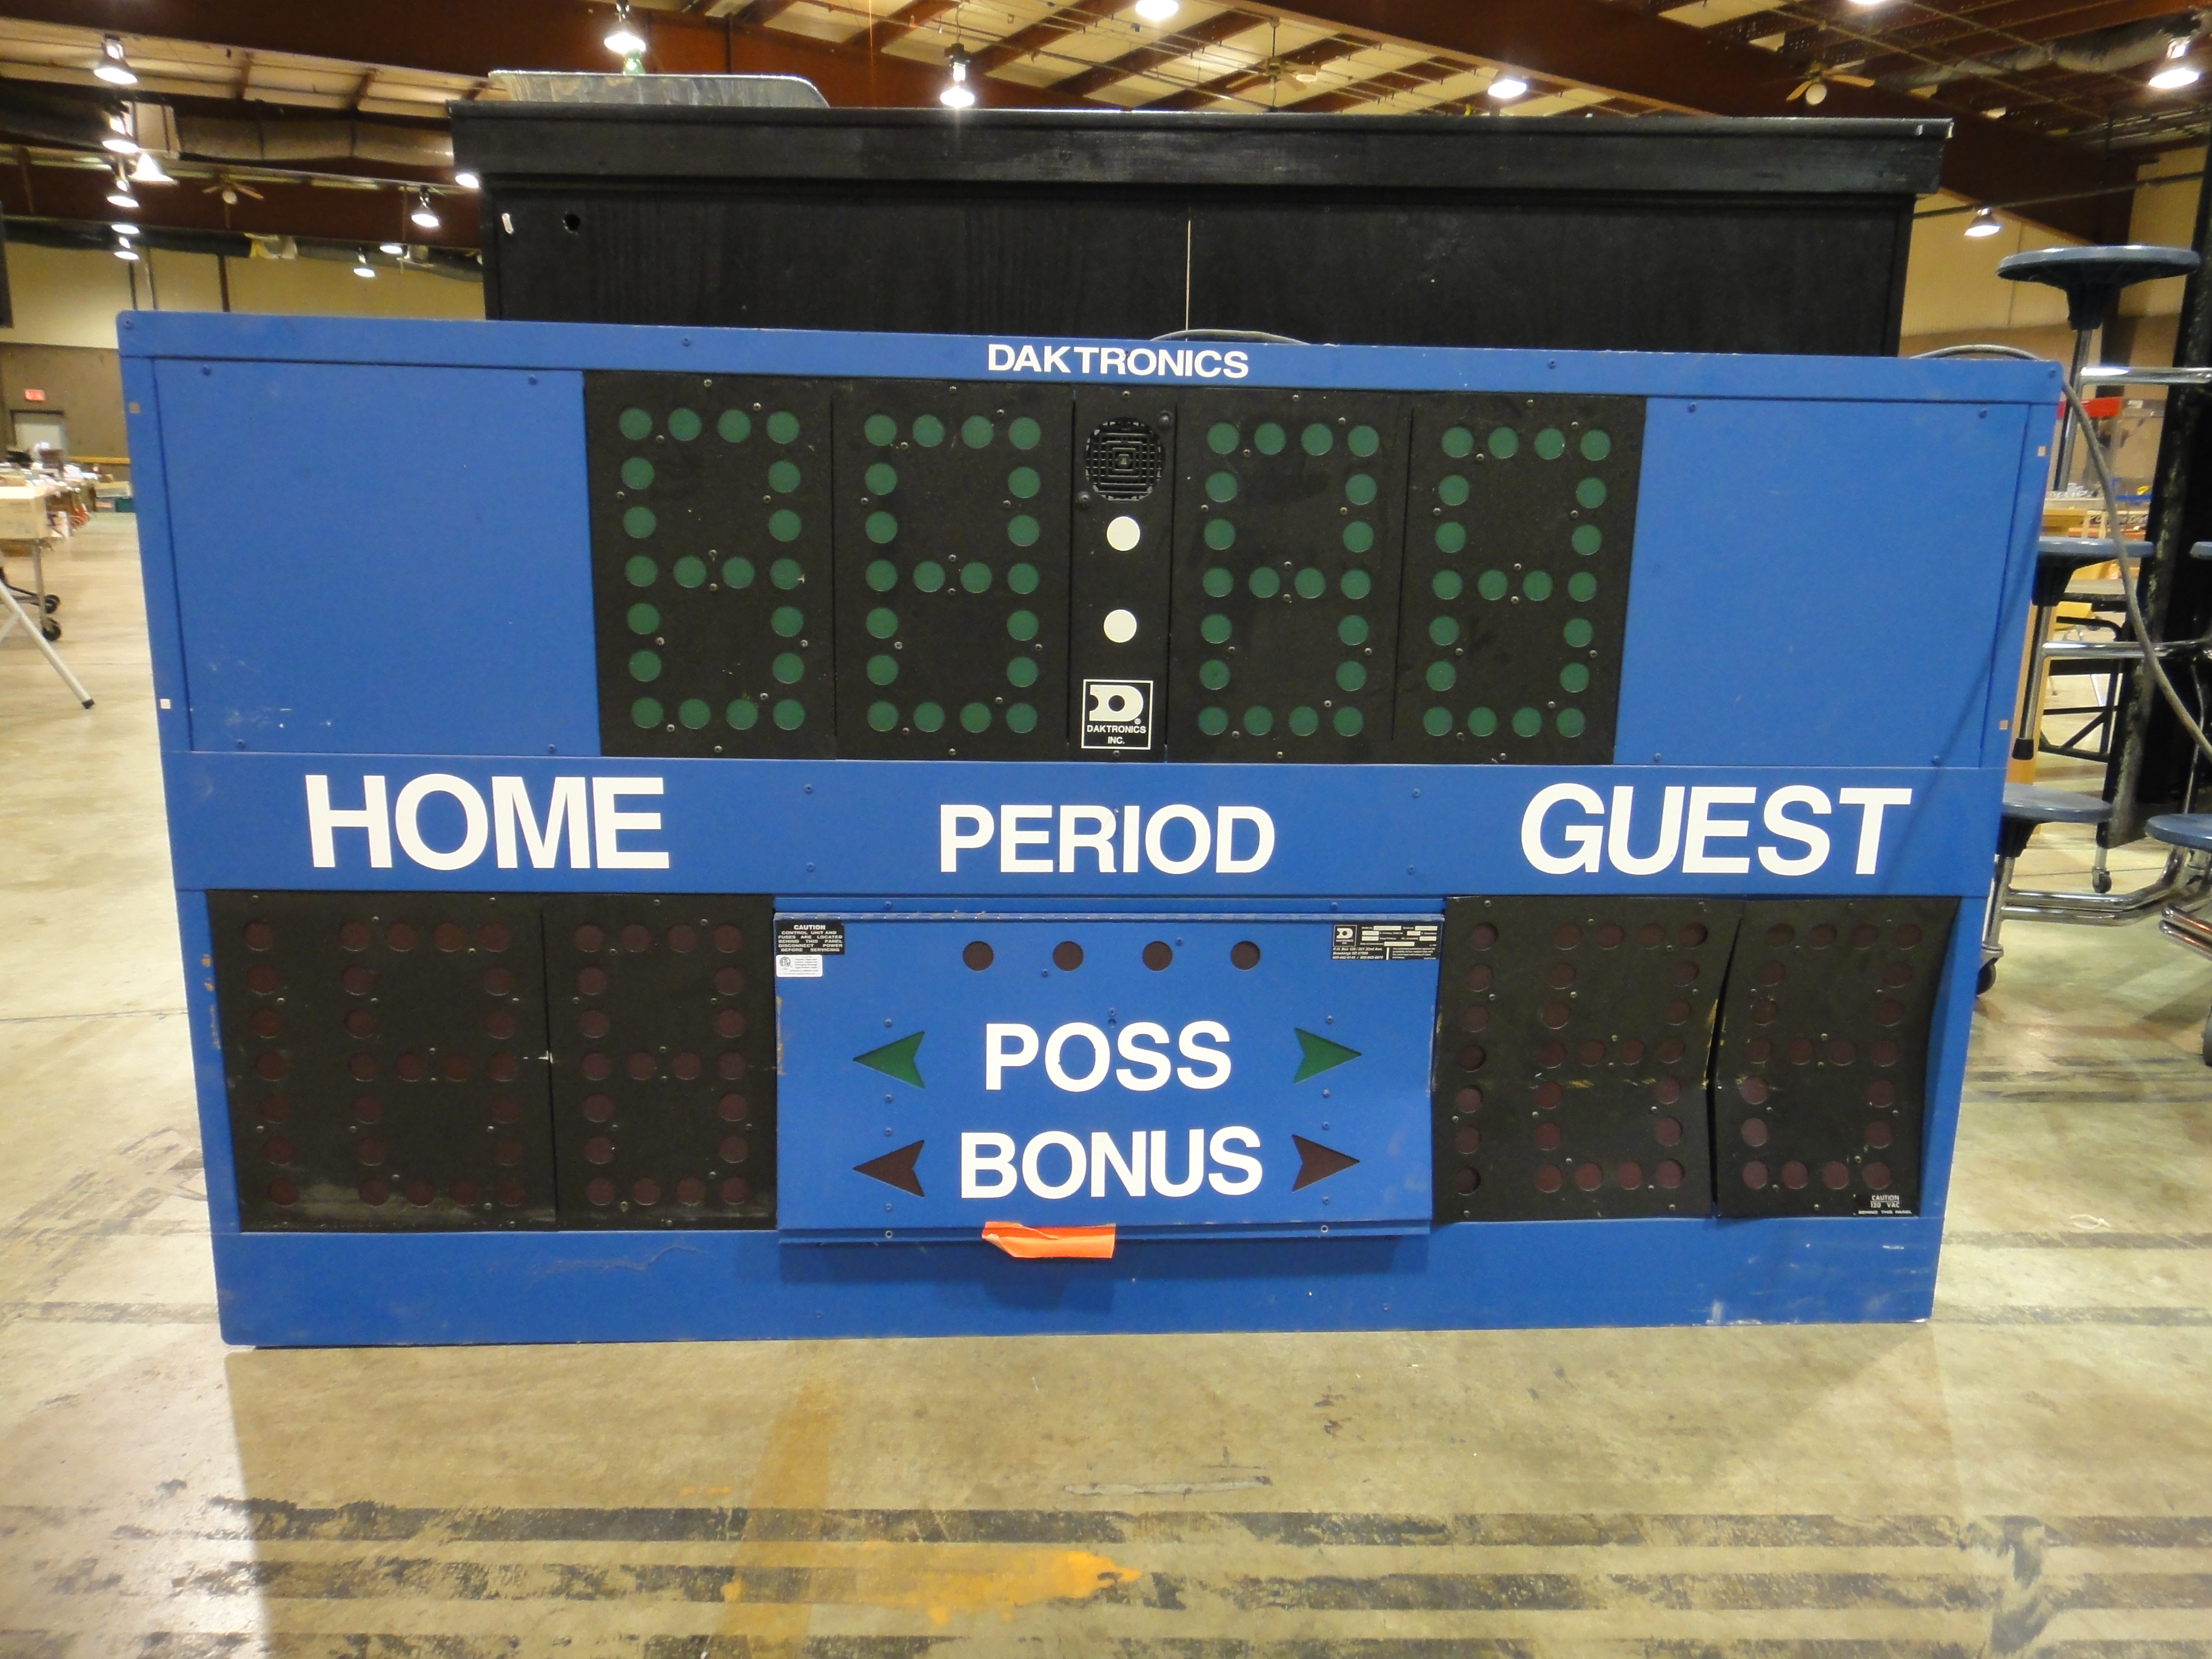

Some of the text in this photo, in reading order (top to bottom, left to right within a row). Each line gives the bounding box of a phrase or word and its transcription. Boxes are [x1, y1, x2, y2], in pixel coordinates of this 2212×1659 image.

[988, 343, 1250, 379] DAKTRONICS
[1087, 725, 1147, 734] DAKTRONICS
[305, 773, 670, 871] HOME
[940, 803, 1275, 875] PERIOD
[1521, 782, 1912, 876] GUEST
[985, 1020, 1232, 1093] POSS
[961, 1125, 1263, 1199] BONUS
